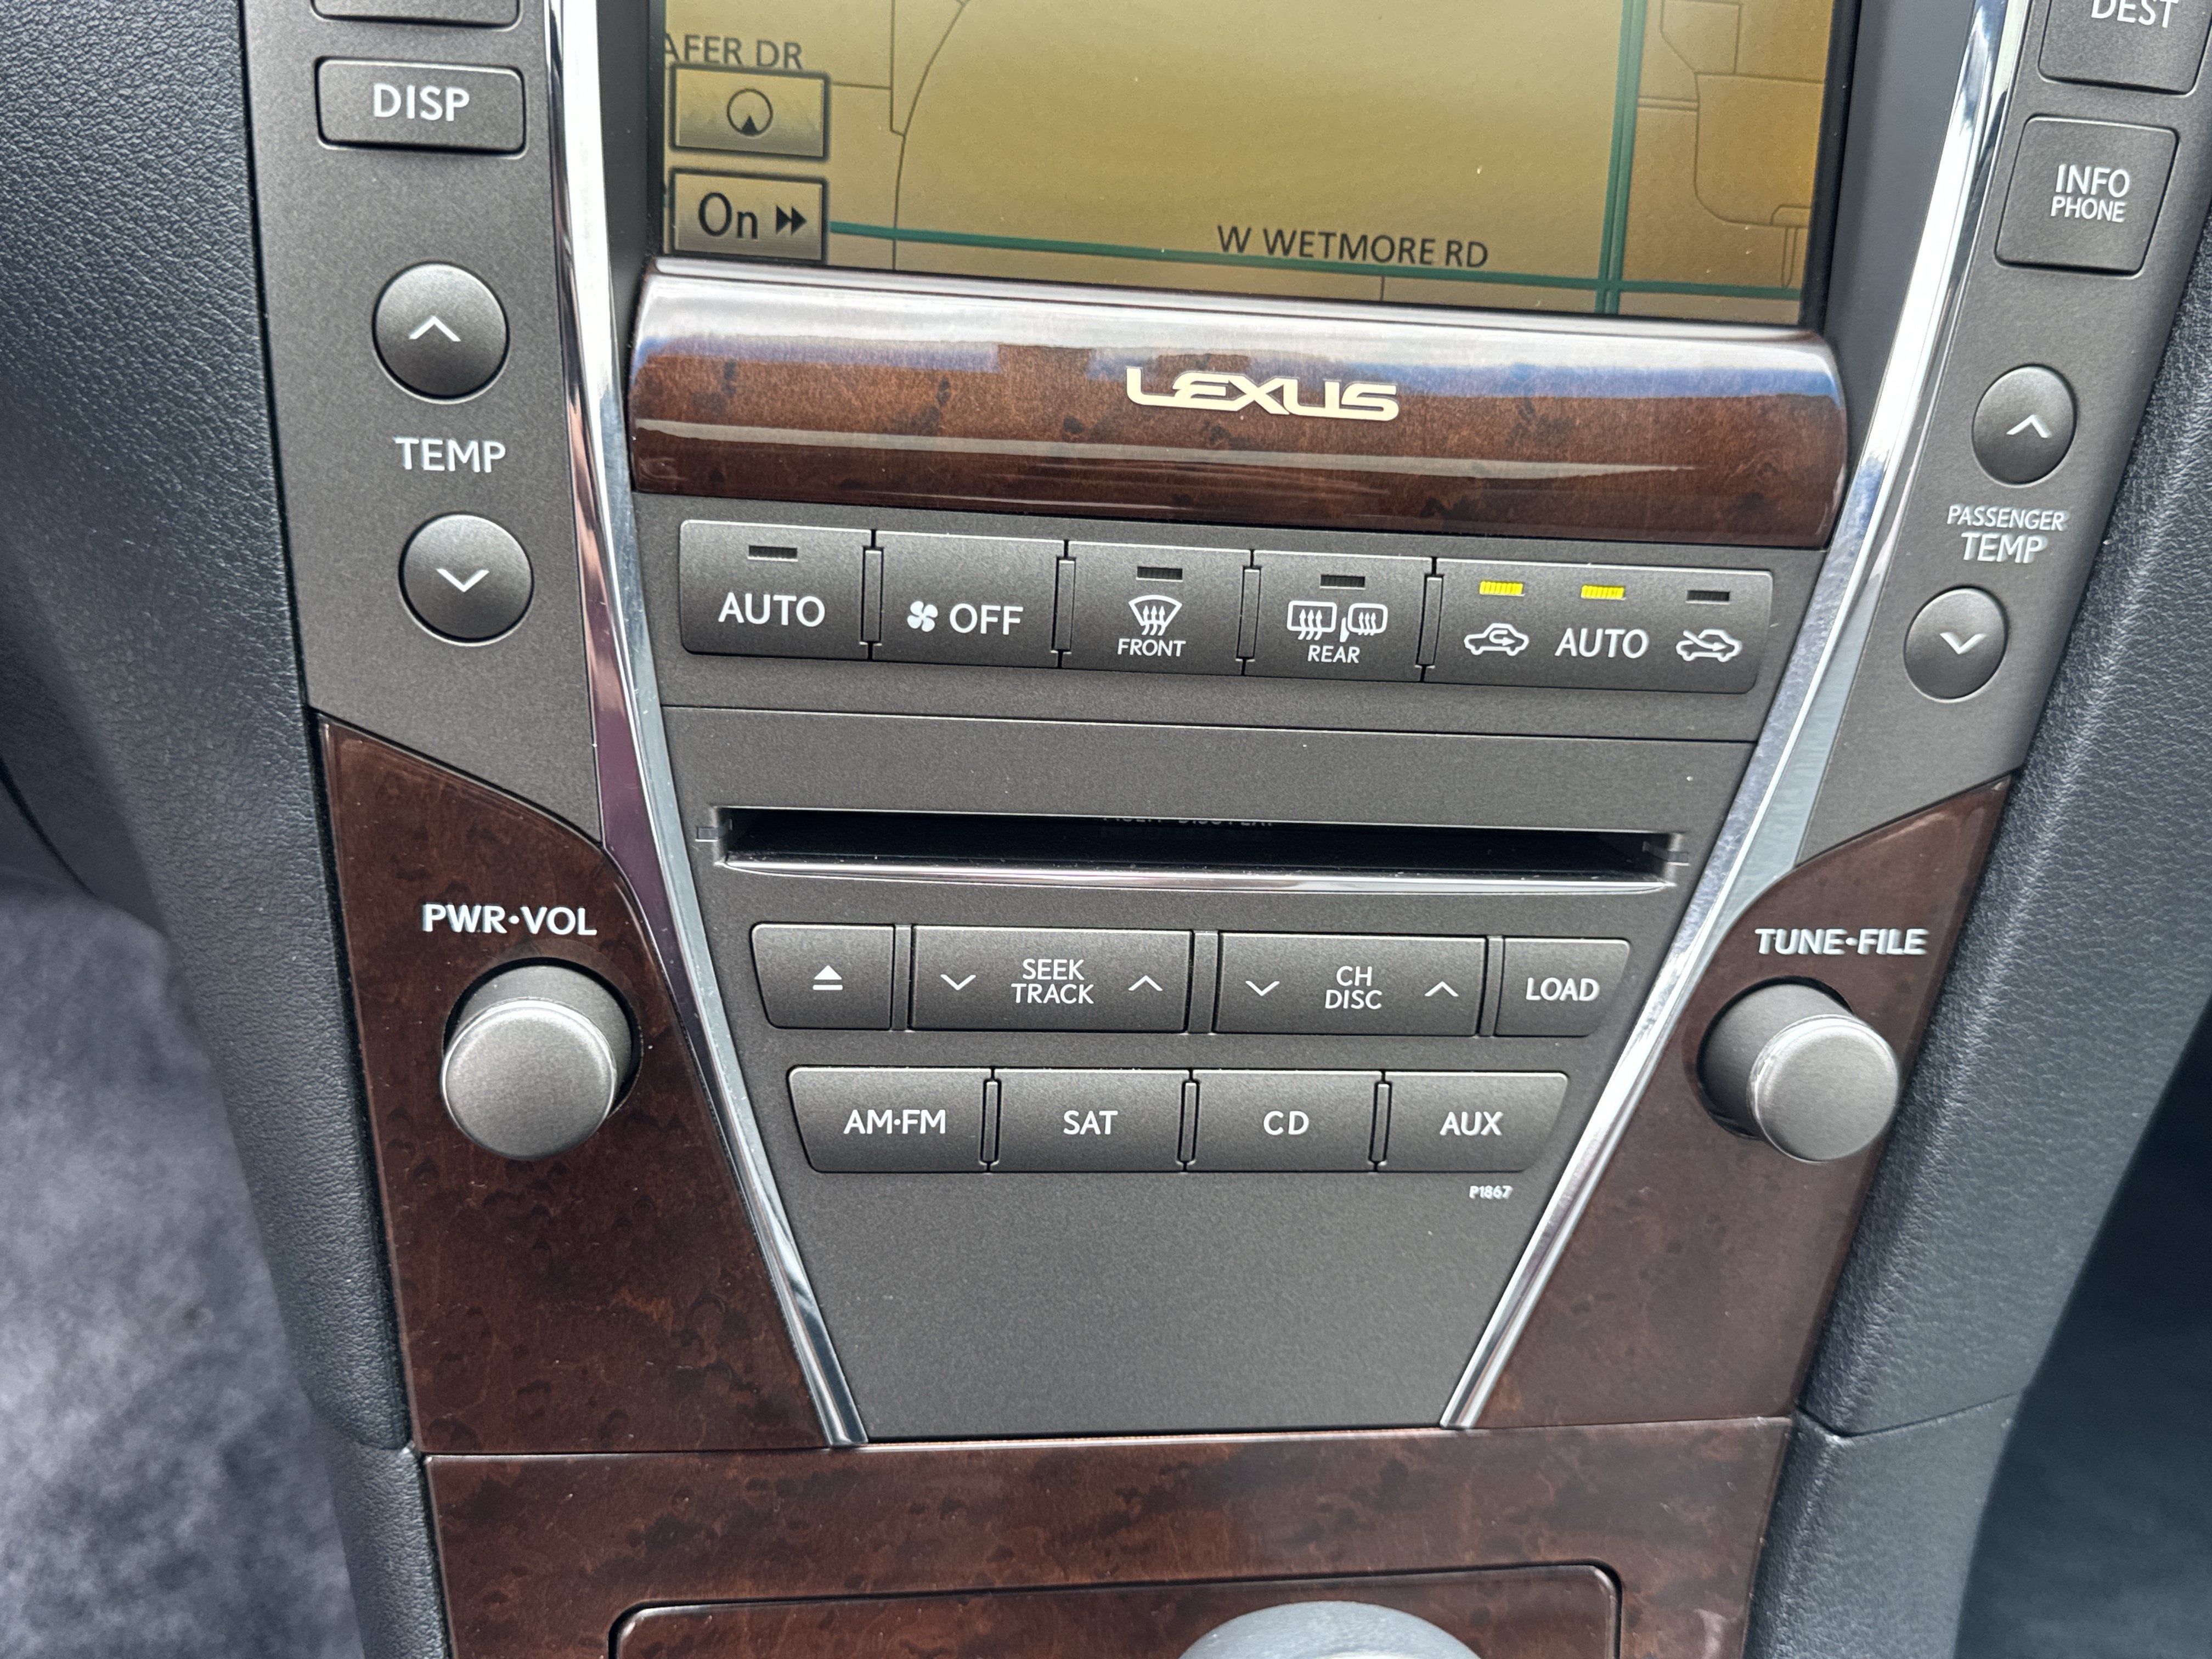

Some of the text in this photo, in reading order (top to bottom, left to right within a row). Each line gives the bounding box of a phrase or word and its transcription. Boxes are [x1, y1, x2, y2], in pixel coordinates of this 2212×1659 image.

[2091, 0, 2179, 28] DEST
[756, 40, 803, 70] DR
[373, 83, 470, 121] DISP
[2055, 163, 2130, 198] INFO
[698, 192, 758, 239] On
[2050, 196, 2126, 223] PHONE
[1217, 225, 1488, 268] W WETMORE RD
[1126, 366, 1400, 421] LEXUS
[393, 436, 506, 472] TEMP
[1947, 504, 2070, 532] PASSENGER
[1961, 531, 2049, 563] TEMP
[718, 592, 825, 627] AUTO
[949, 603, 1024, 635] OFF
[1117, 638, 1186, 657] FRONT
[1307, 645, 1361, 664] REAR
[1555, 628, 1649, 659] AUTO
[1022, 958, 1085, 981] SEEK
[1336, 966, 1373, 987] CH
[1011, 983, 1094, 1005] TRACK
[1325, 989, 1383, 1009] DISC
[1526, 978, 1599, 1002] LOAD
[1063, 1110, 1119, 1135] SAT
[1263, 1110, 1310, 1136] CD
[1440, 1111, 1504, 1136] AUX
[1469, 1184, 1514, 1200] P1867
